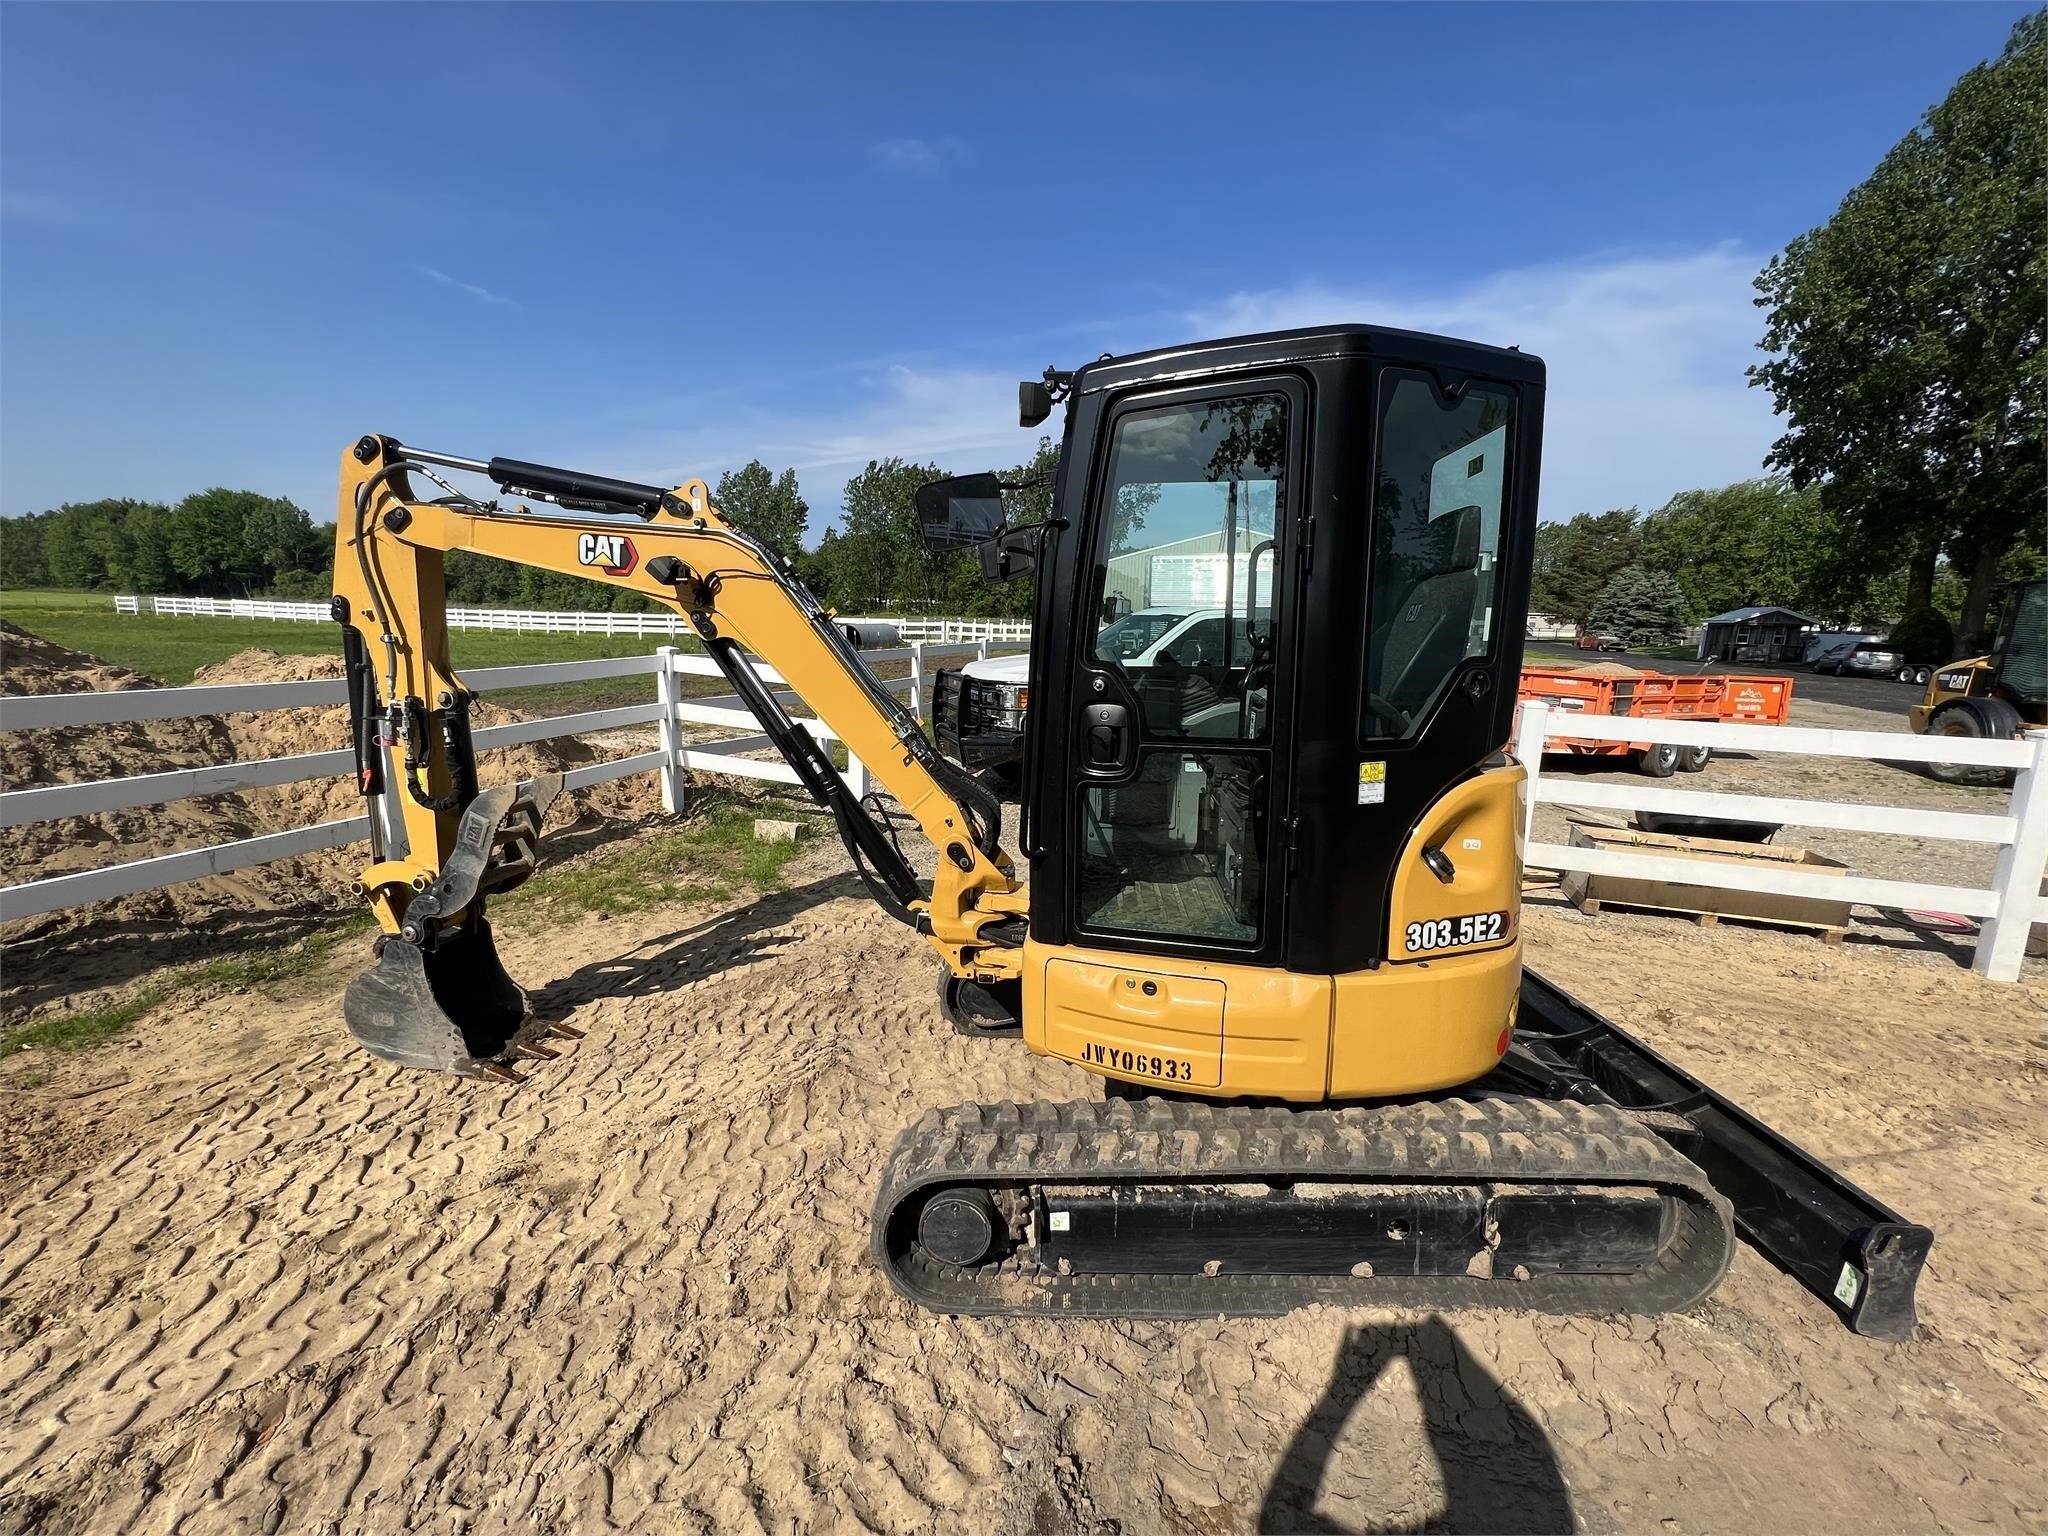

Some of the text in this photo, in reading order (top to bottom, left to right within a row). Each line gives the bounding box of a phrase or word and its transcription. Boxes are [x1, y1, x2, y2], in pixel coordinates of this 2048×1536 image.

[579, 533, 625, 568] CAT
[1949, 675, 1969, 689] CAT
[1406, 913, 1502, 951] 303.5E2
[1081, 1042, 1192, 1081] JWY06933
